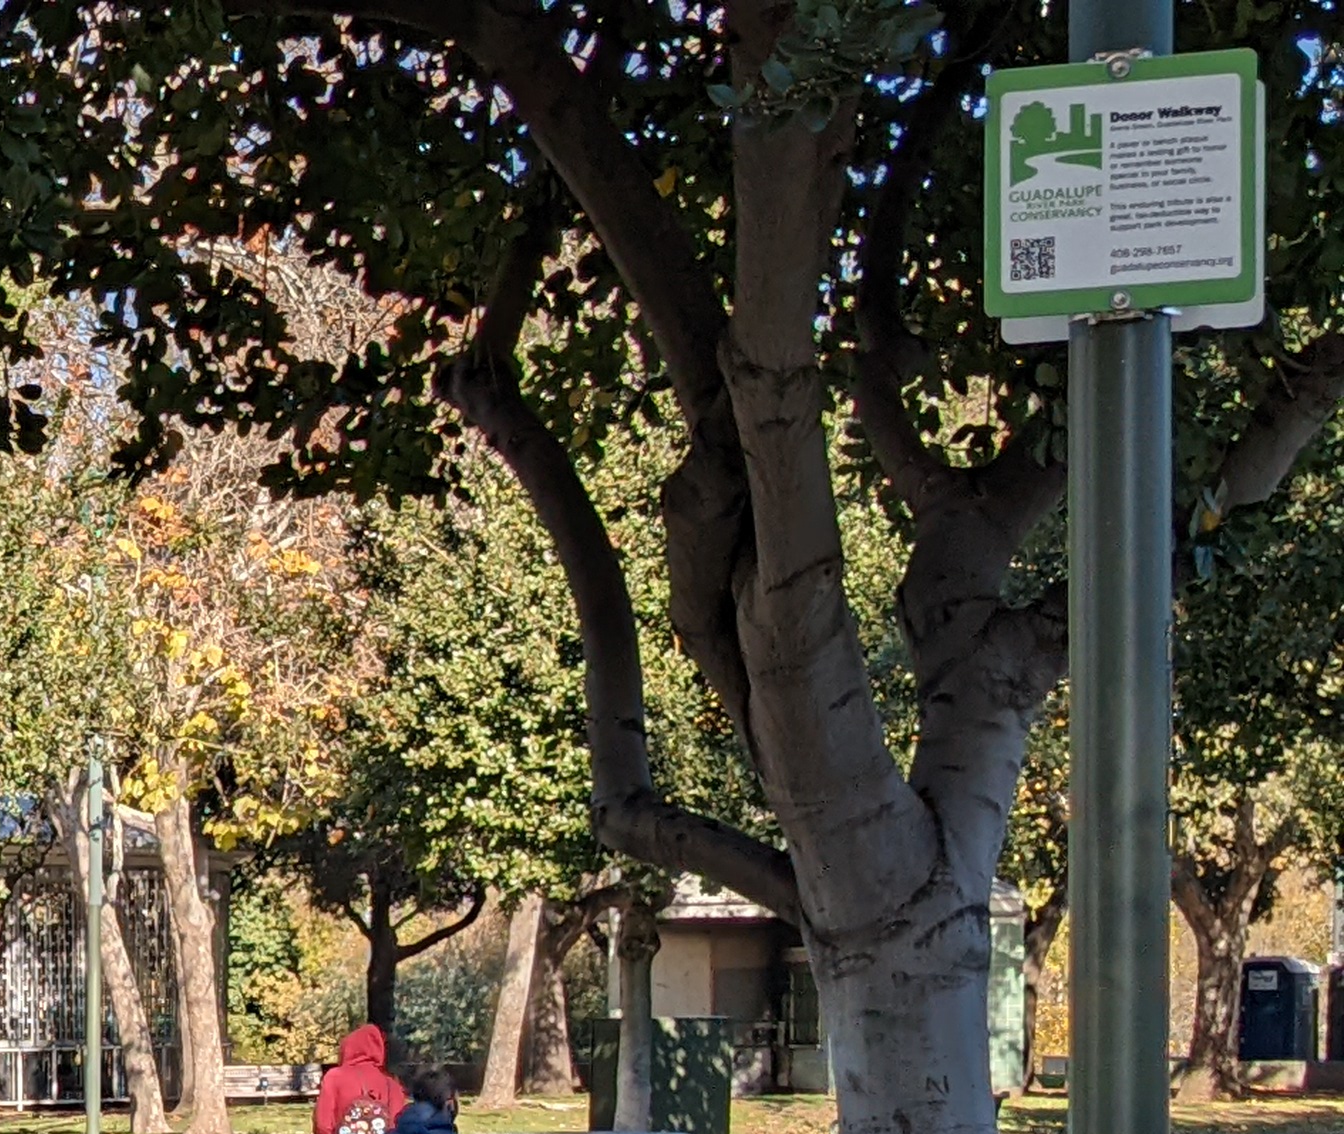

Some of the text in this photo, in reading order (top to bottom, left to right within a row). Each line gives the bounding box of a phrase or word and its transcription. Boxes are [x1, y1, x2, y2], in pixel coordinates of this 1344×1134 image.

[1110, 105, 1222, 122] Donor Walkway
[1009, 184, 1103, 202] GUADALUPE
[1010, 206, 1102, 222] CONSERVANCY
